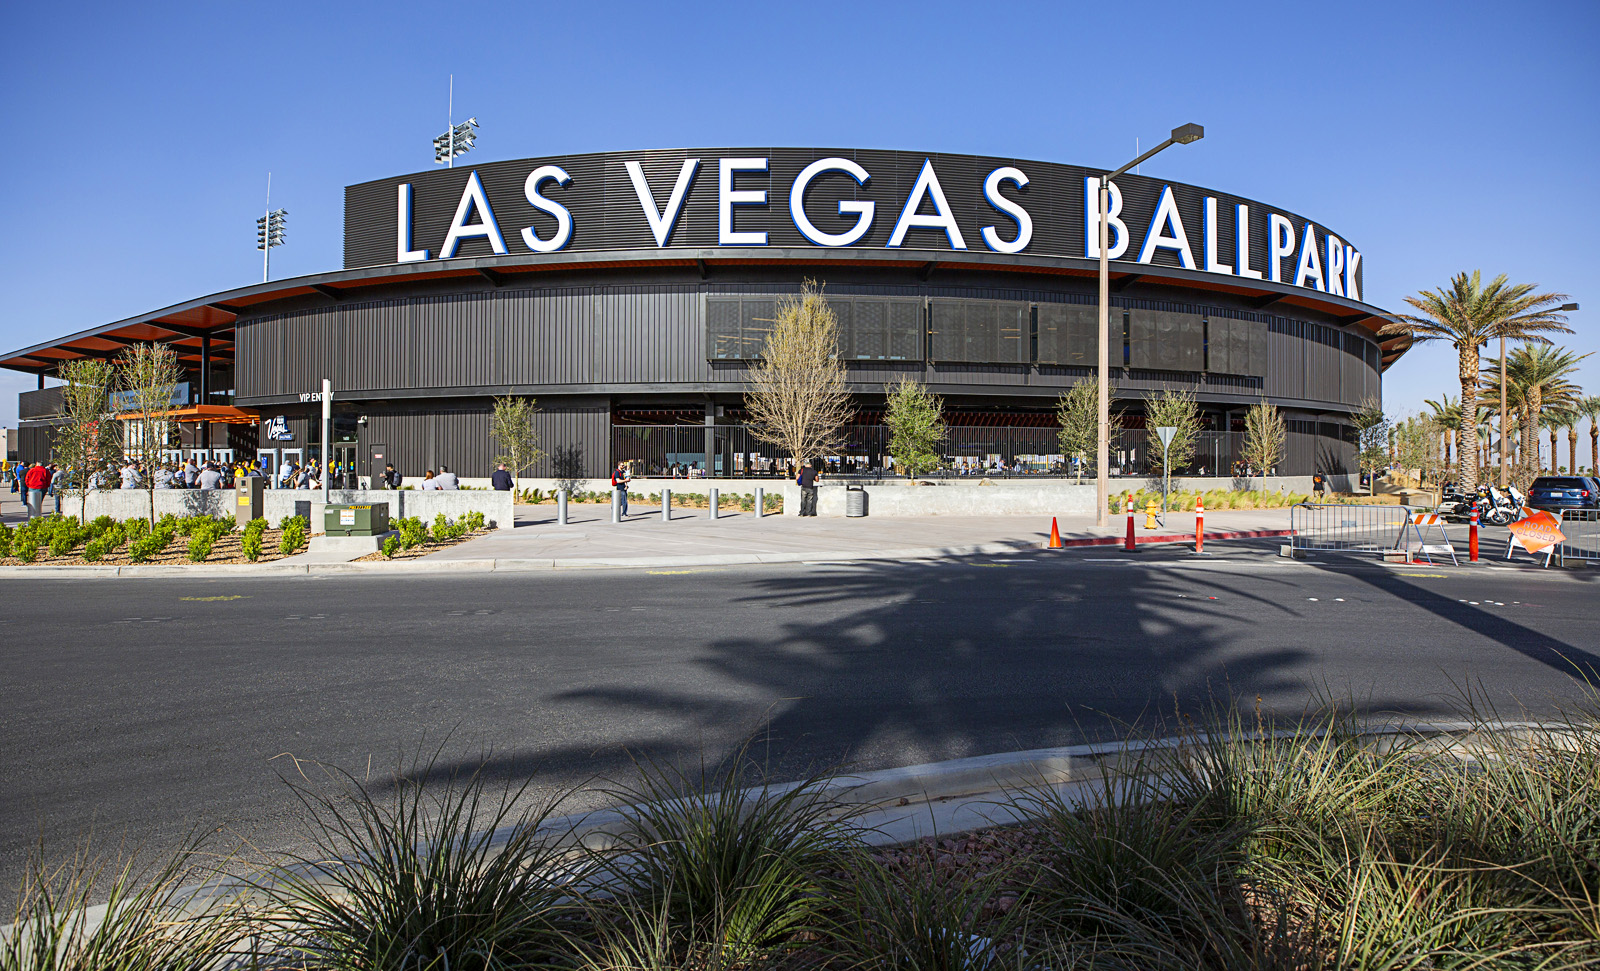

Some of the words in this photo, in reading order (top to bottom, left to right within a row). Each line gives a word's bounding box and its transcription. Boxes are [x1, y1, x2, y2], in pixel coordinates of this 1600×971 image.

[398, 165, 574, 262] LAS
[624, 157, 1033, 253] VEGAS
[1084, 176, 1363, 301] BALLPARK
[299, 393, 310, 402] VIP
[311, 392, 334, 402] ENTY
[1523, 520, 1552, 533] ROAD
[1516, 527, 1556, 542] CLOSED
